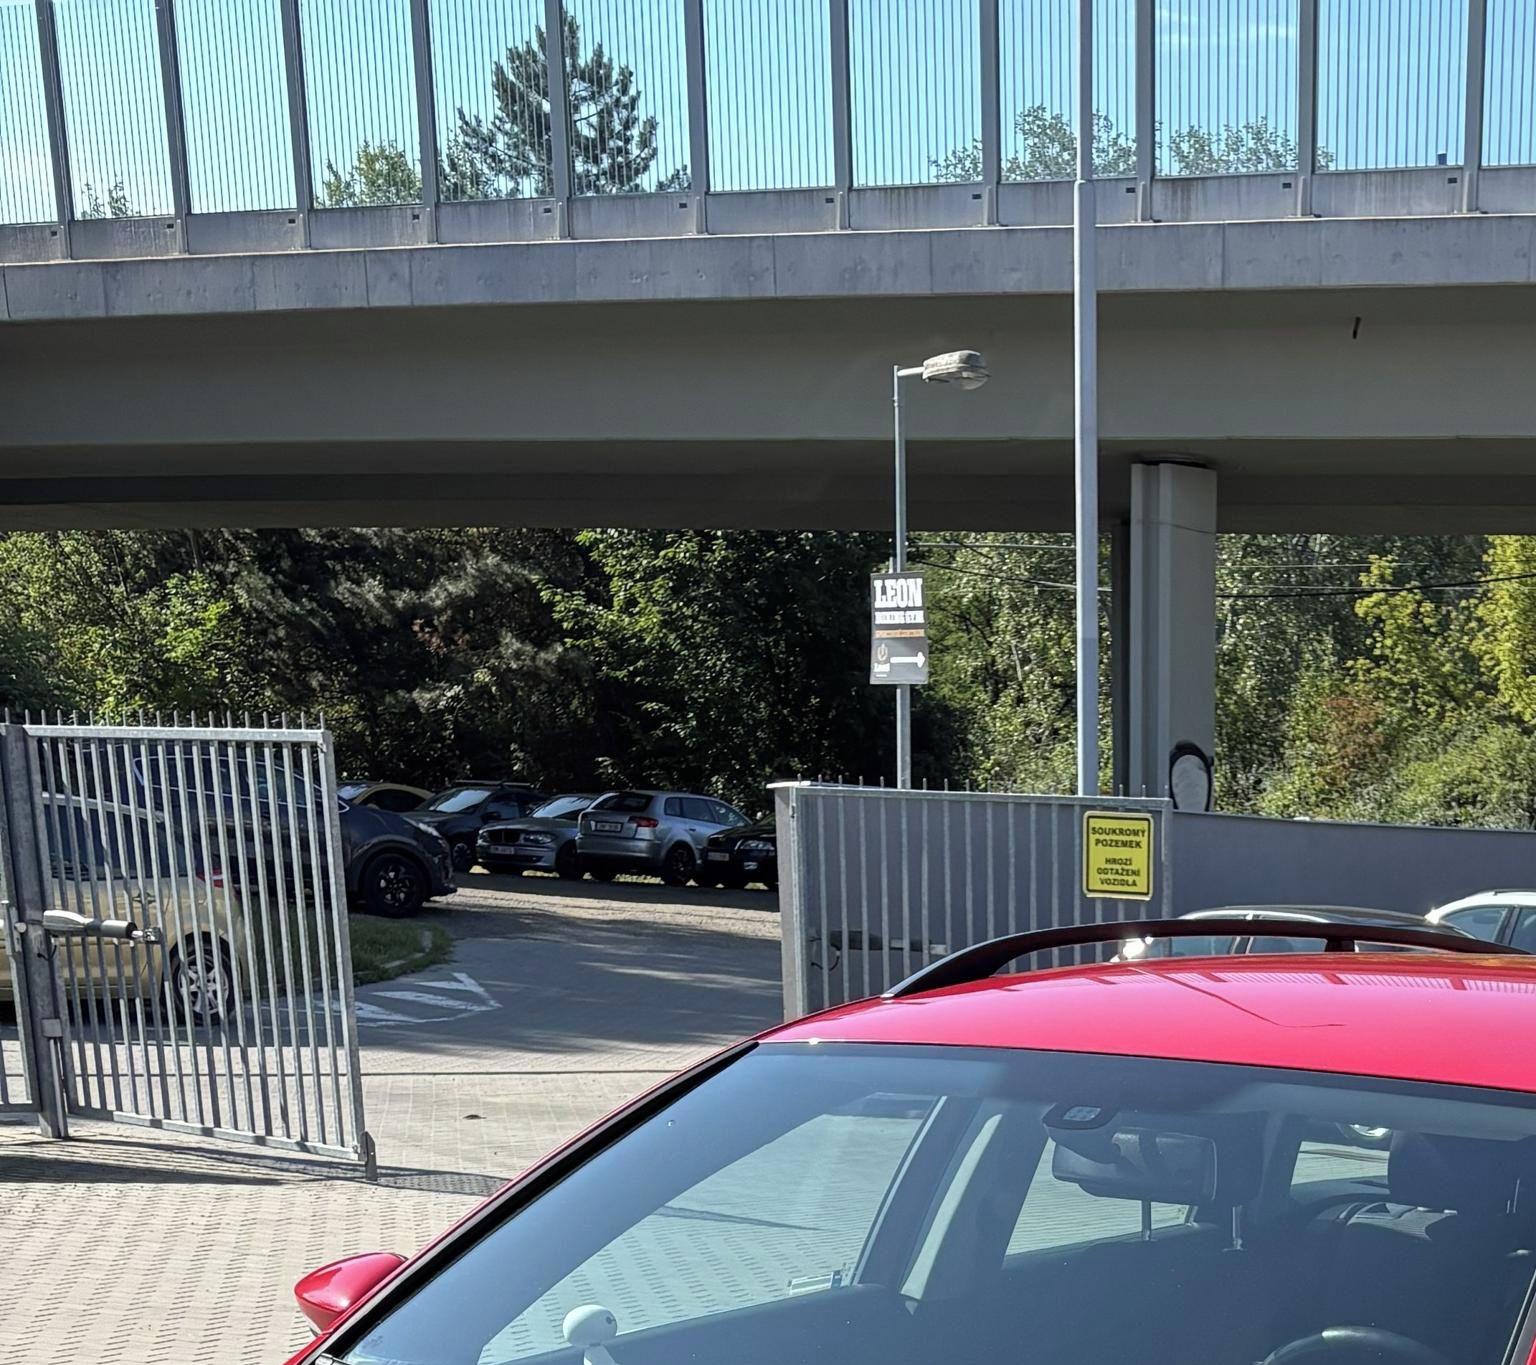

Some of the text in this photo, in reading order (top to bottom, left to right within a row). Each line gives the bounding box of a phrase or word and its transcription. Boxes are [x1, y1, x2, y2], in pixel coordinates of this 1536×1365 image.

[874, 578, 923, 608] LEON
[1091, 826, 1145, 837] SOUKROMÝ
[1095, 838, 1142, 848] POZEMEK
[1104, 857, 1132, 865] HROZÍ
[1099, 877, 1137, 886] VOZIDLA
